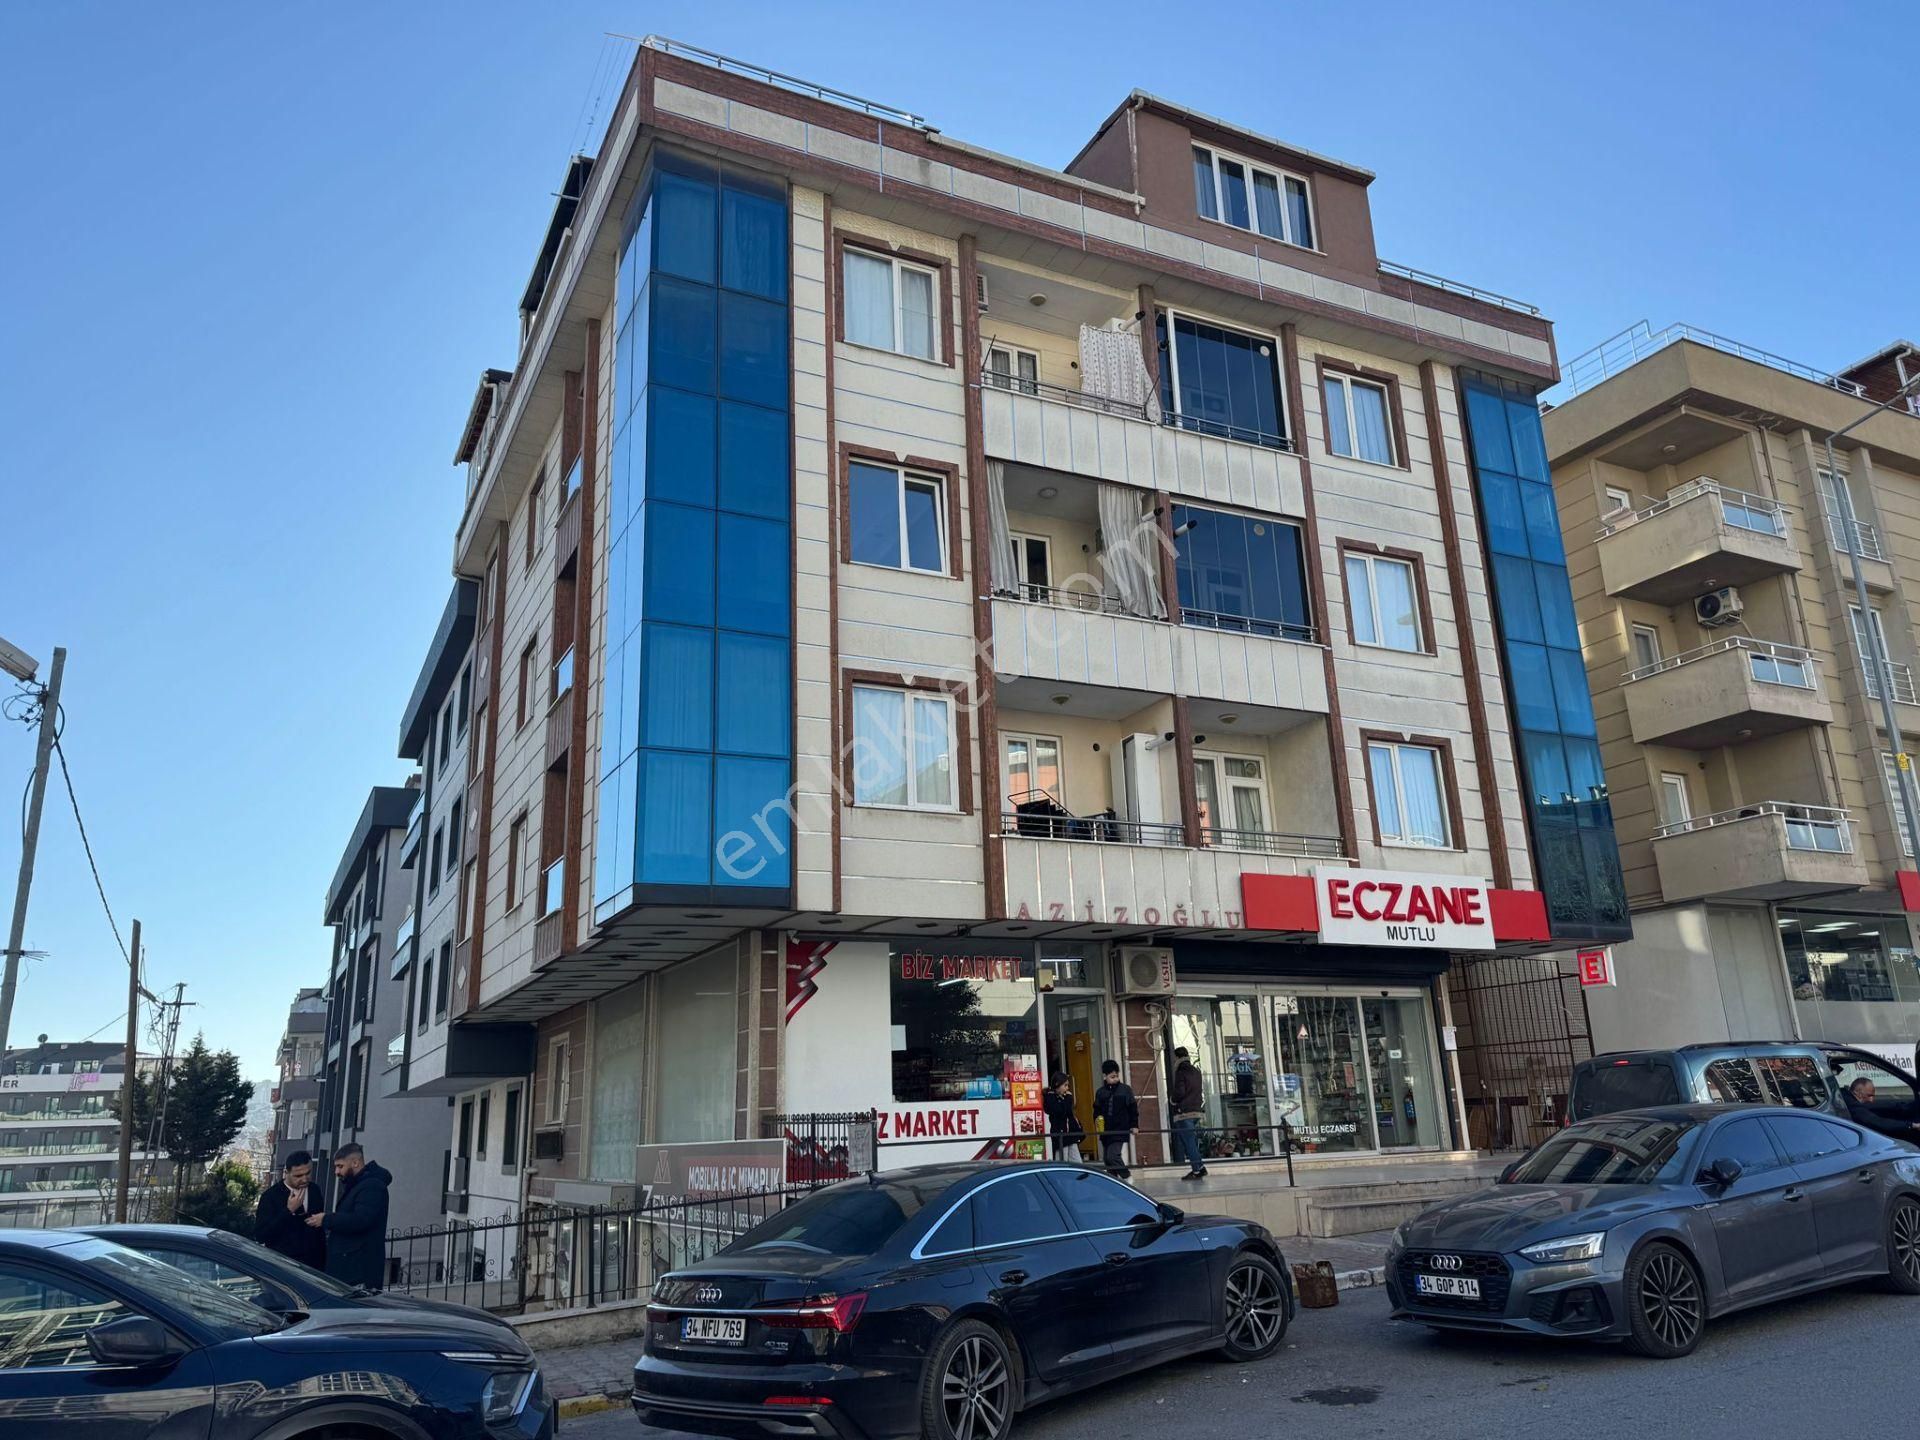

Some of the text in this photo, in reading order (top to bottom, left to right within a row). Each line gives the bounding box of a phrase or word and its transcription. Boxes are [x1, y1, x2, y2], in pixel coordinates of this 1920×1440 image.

[1327, 878, 1485, 925] ECZANE
[1386, 925, 1437, 942] MUTLU
[901, 950, 1023, 983] BİZ MARKET
[1585, 958, 1600, 979] E
[0, 1079, 19, 1089] ER
[894, 1108, 980, 1139] MARKET
[1293, 1122, 1357, 1135] MUTLU ECZANESİ
[1421, 1276, 1478, 1296] 34 GOP 814
[686, 1319, 741, 1339] 34 NFU 769
